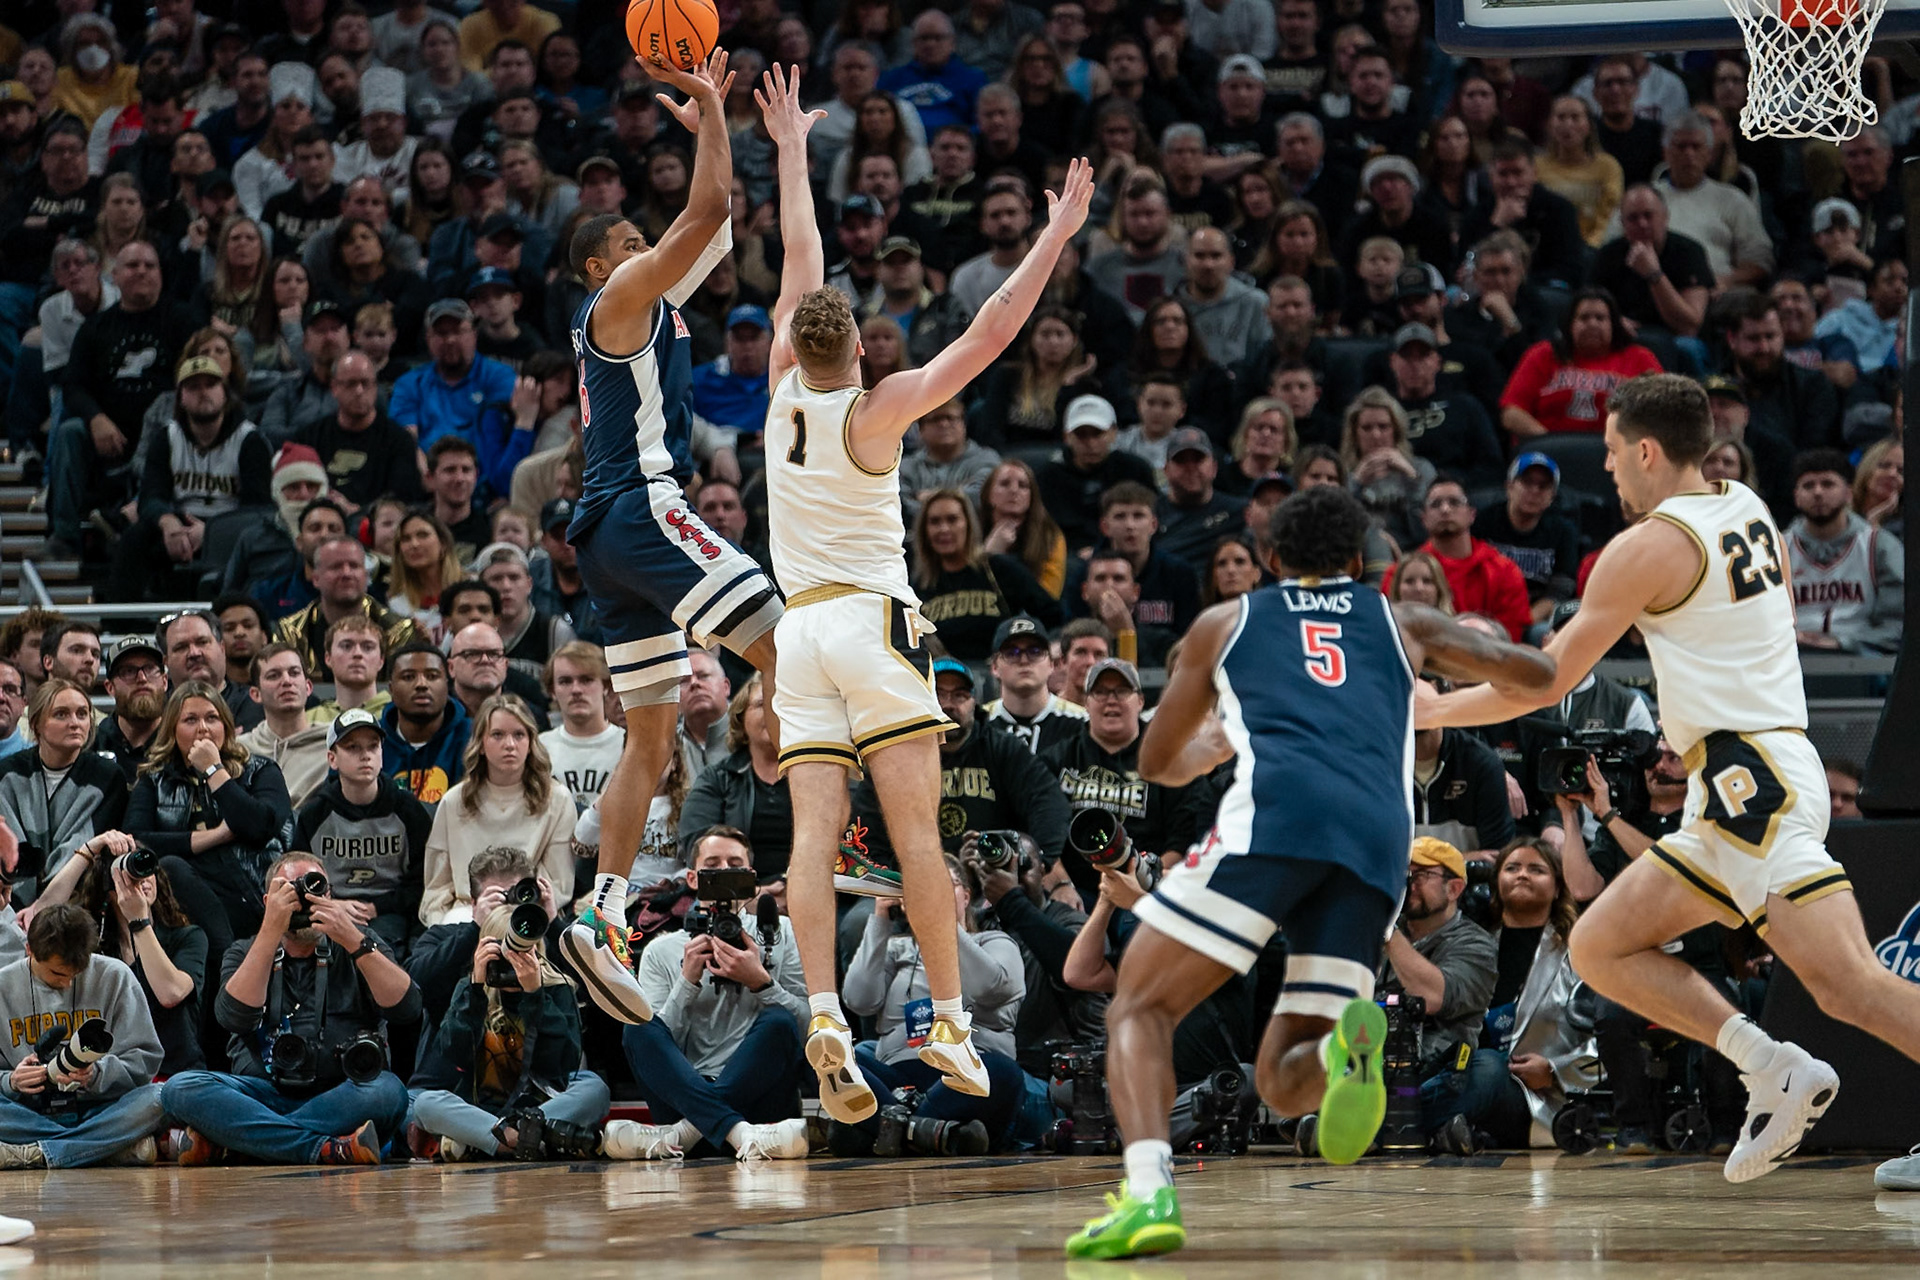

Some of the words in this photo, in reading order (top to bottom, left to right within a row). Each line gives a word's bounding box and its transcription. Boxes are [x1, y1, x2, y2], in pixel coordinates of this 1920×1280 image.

[786, 407, 808, 468] 1
[665, 508, 722, 561] CATS
[1719, 518, 1785, 604] 23
[1282, 588, 1354, 615] LEWIS
[1300, 619, 1347, 688] 5
[941, 766, 997, 802] RDUE
[1712, 764, 1759, 819] P
[321, 834, 400, 861] PURDUE
[345, 868, 376, 886] P
